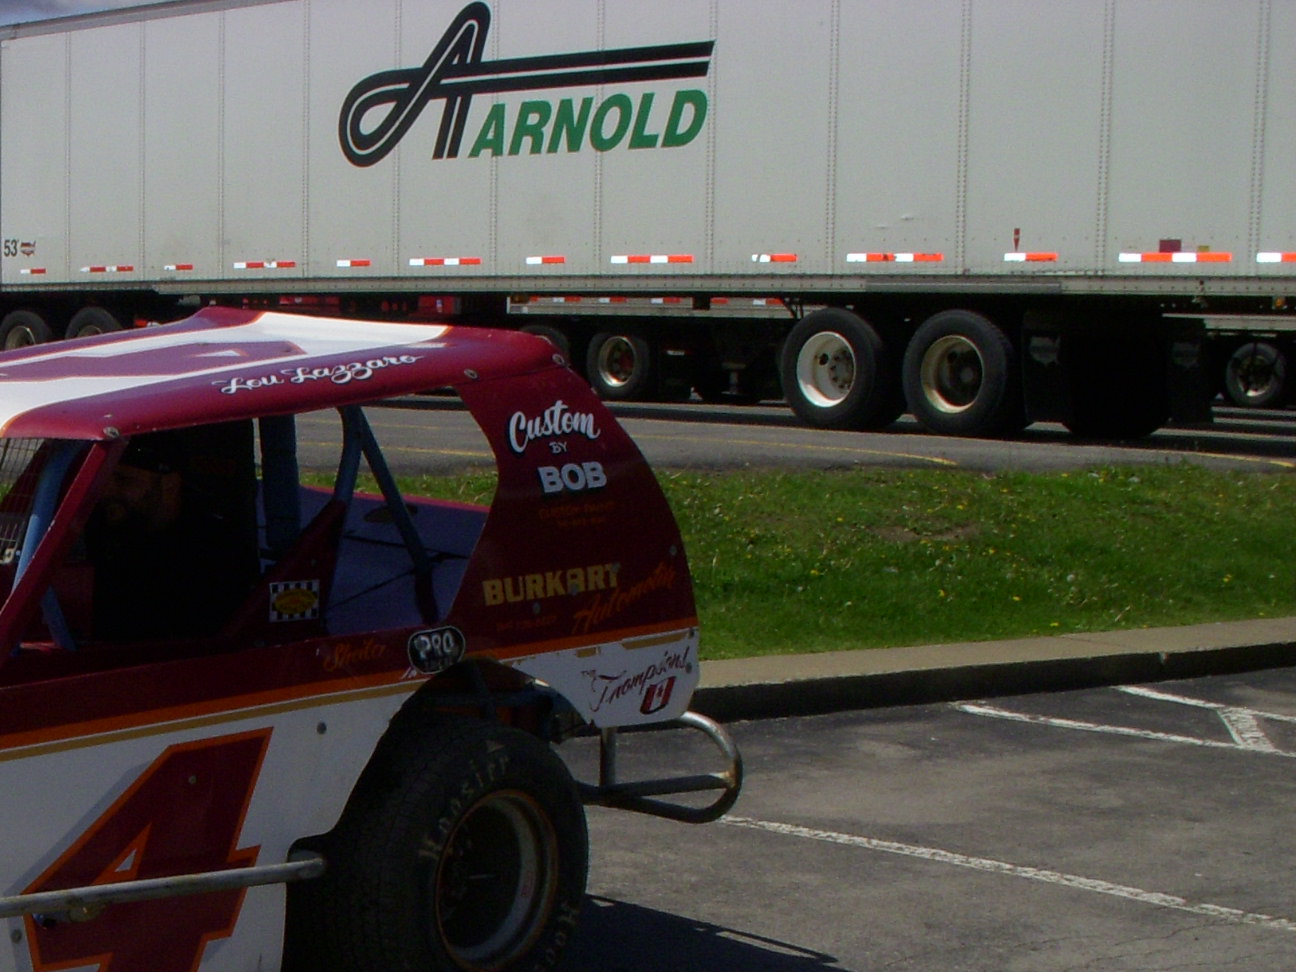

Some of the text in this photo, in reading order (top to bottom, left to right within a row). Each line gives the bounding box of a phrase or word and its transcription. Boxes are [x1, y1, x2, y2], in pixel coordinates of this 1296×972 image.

[468, 88, 708, 159] ARNOLD
[212, 354, 425, 394] Lou Lazzaro
[508, 400, 602, 454] Custom
[548, 441, 569, 455] BY
[537, 461, 608, 495] BOB
[481, 561, 622, 608] BURKART
